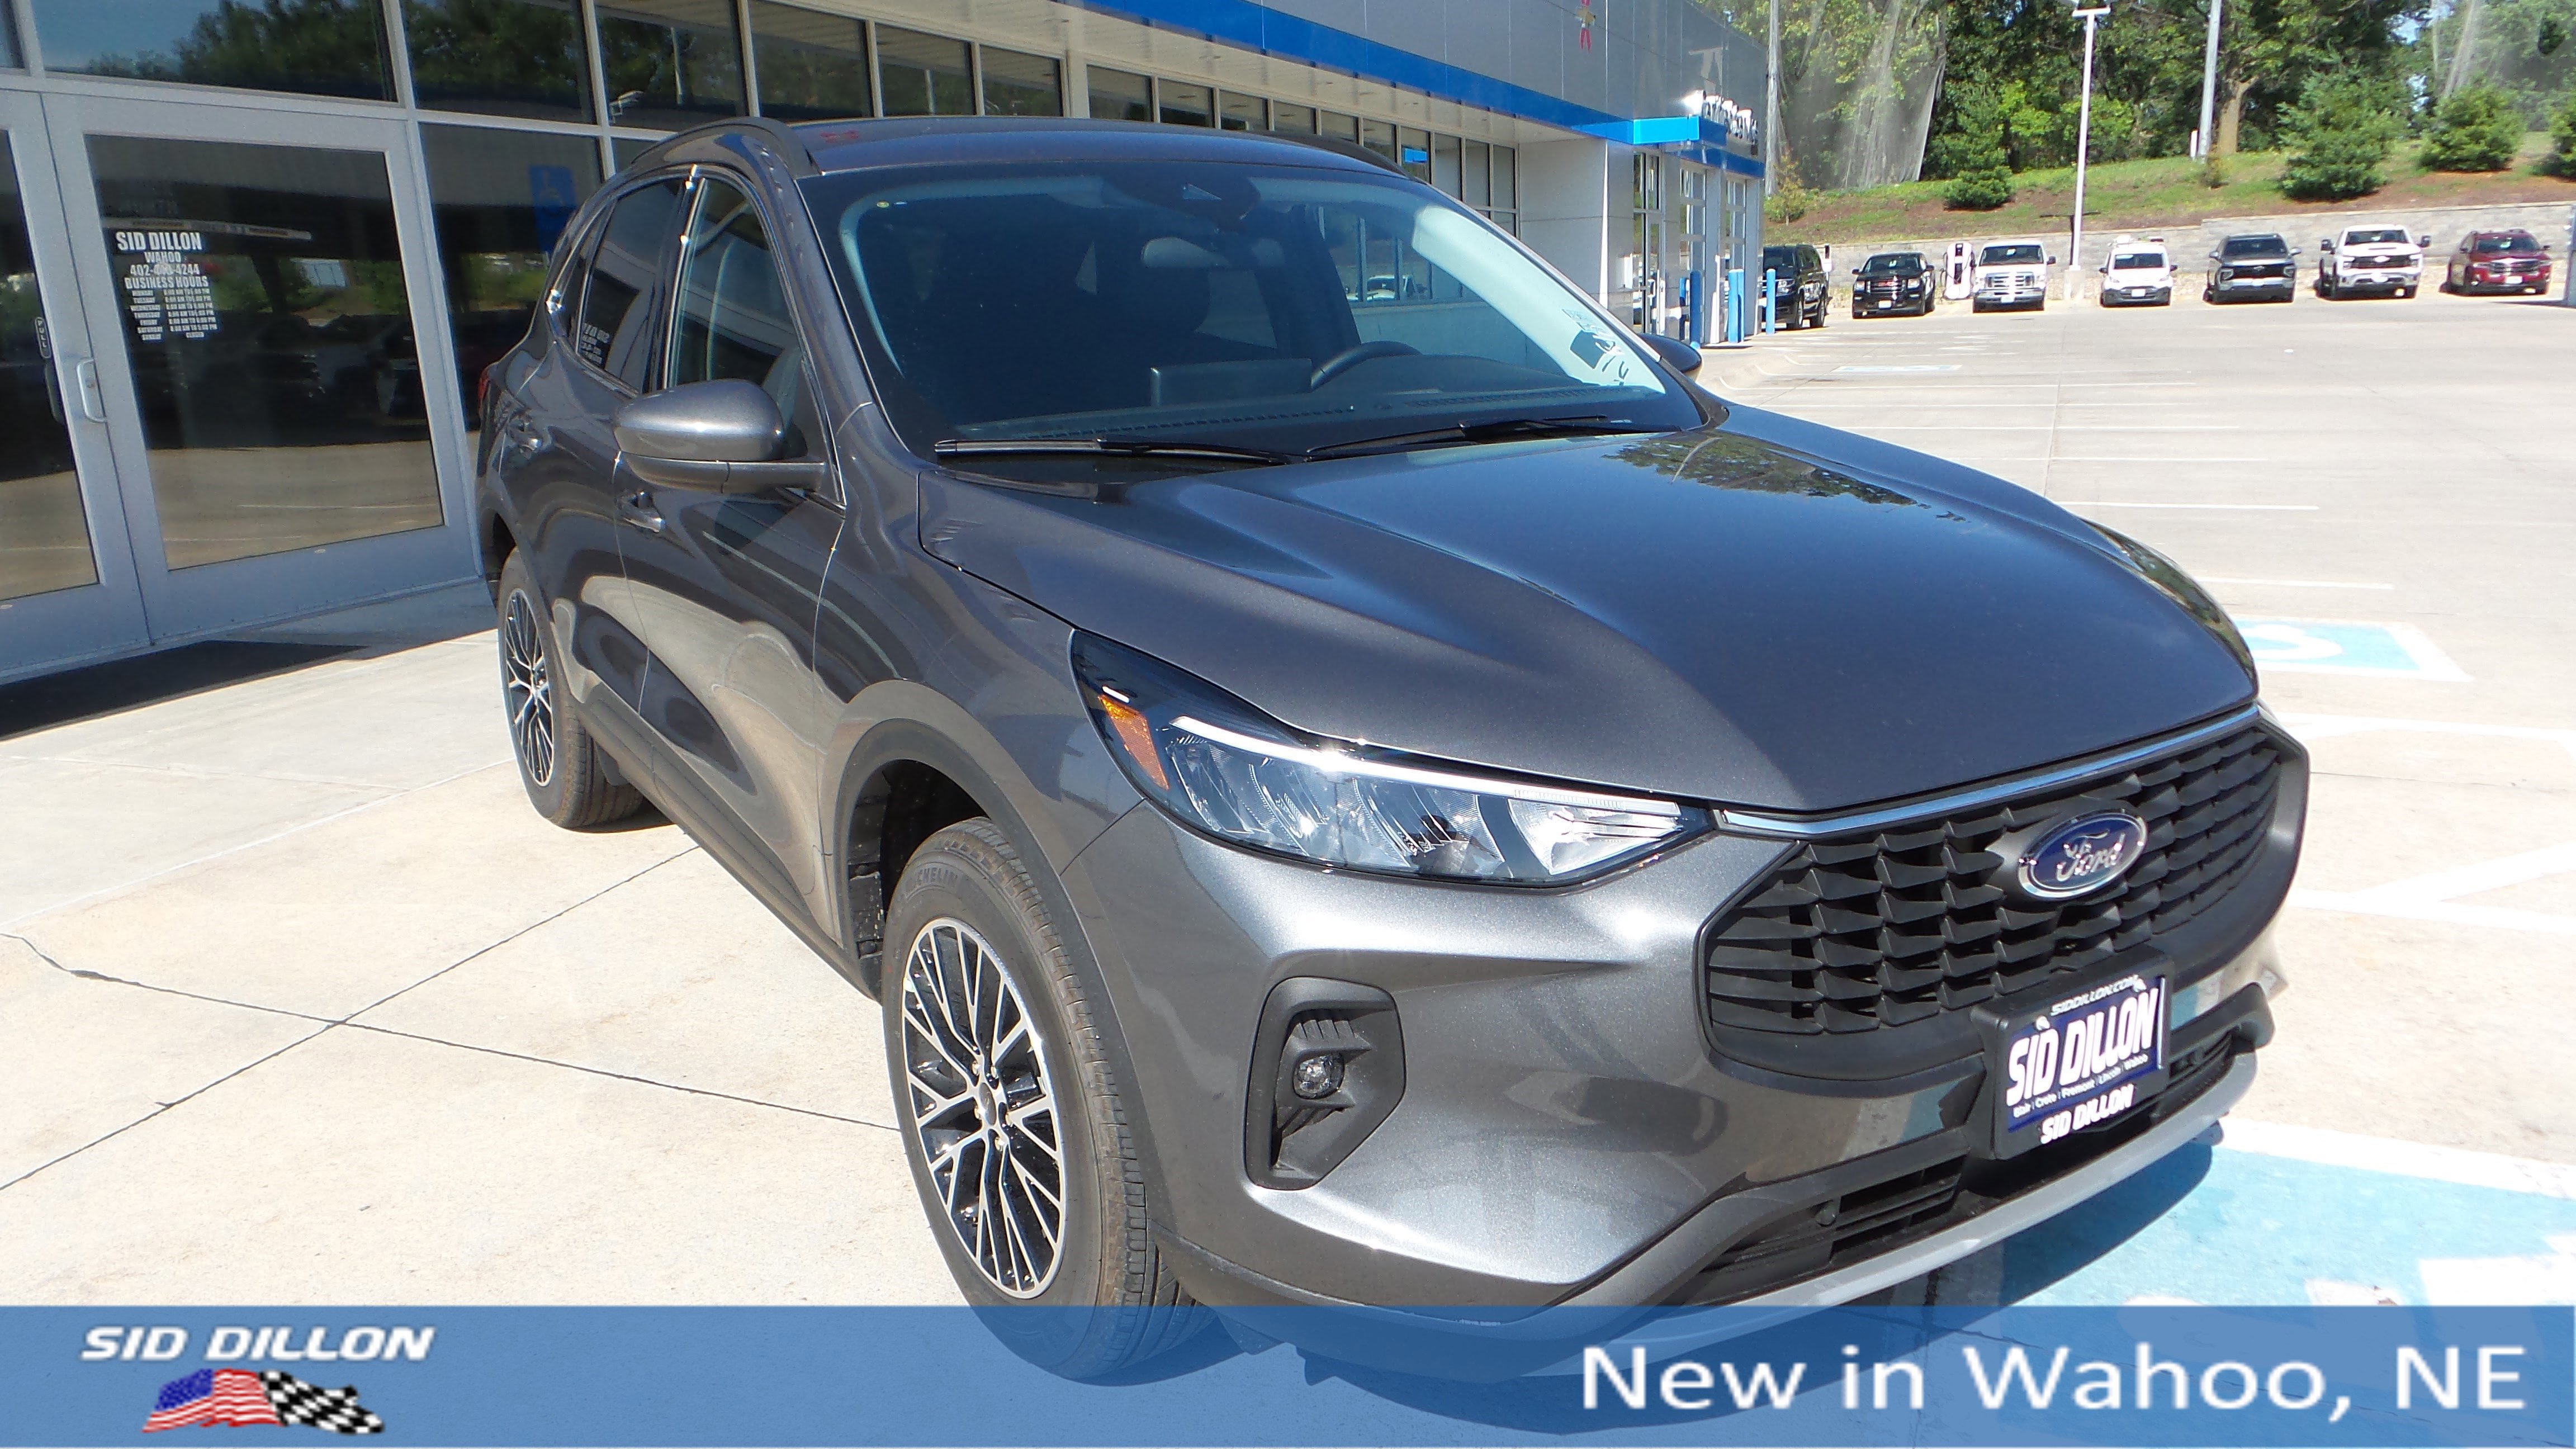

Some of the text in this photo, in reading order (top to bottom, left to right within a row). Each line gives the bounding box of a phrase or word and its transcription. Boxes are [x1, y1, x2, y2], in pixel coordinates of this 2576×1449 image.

[115, 231, 202, 250] SID DILLON
[144, 252, 182, 263] WAHOO
[130, 263, 201, 276] 402-4-4244
[124, 276, 209, 290] BUSINESS HOURS
[2057, 828, 2126, 882] Ford
[903, 867, 960, 894] ICHELIN
[2006, 988, 2159, 1106] SID DILLON
[2040, 1083, 2134, 1144] SID DILLON
